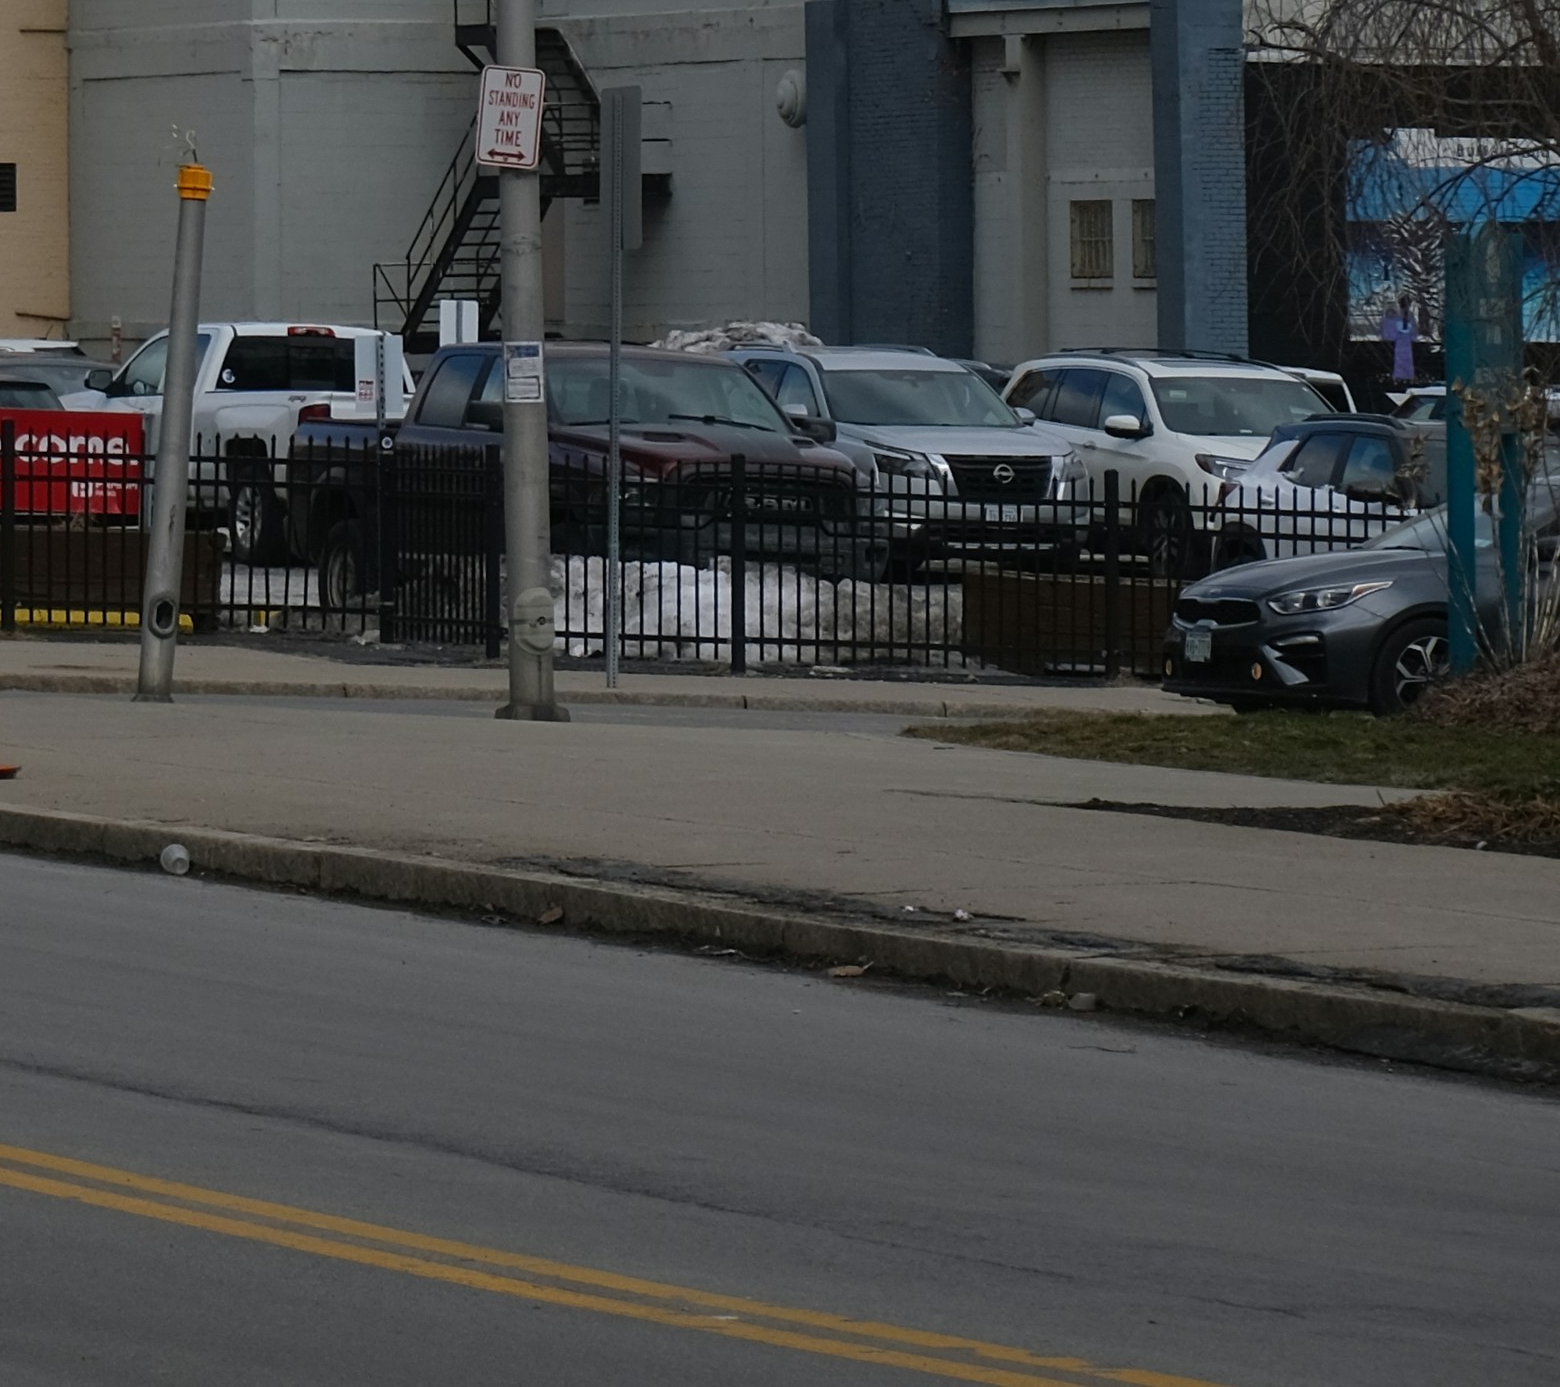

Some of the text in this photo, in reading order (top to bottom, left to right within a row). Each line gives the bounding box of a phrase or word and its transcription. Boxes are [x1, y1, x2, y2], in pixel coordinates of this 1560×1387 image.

[505, 72, 522, 88] NO
[488, 90, 535, 109] STANDING
[499, 110, 520, 127] ANY
[495, 129, 522, 147] TIME
